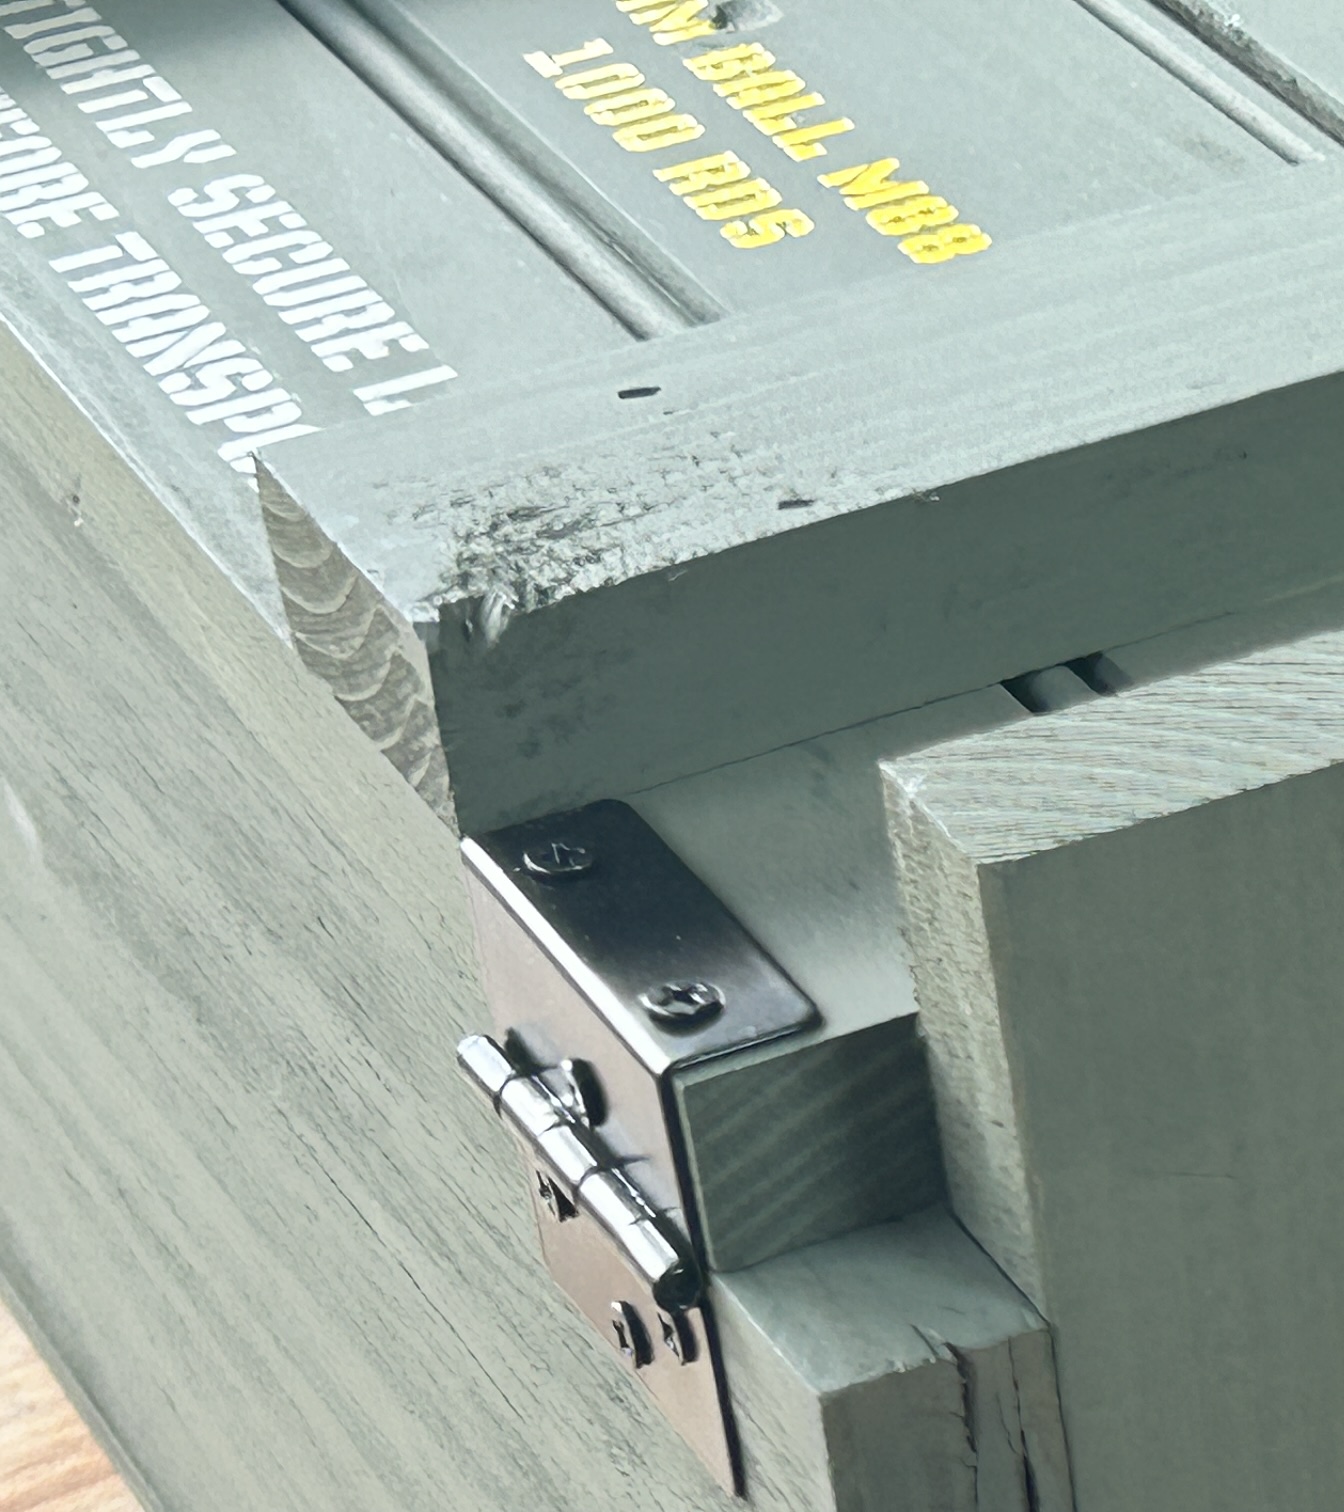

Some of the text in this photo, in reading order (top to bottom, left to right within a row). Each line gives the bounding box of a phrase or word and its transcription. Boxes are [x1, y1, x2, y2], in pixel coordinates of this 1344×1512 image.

[0, 0, 237, 168] TIGHTLY
[168, 173, 430, 372] SECURE
[523, 37, 815, 249] 1000 RDS
[615, 0, 717, 46] M
[682, 42, 856, 161] BALL
